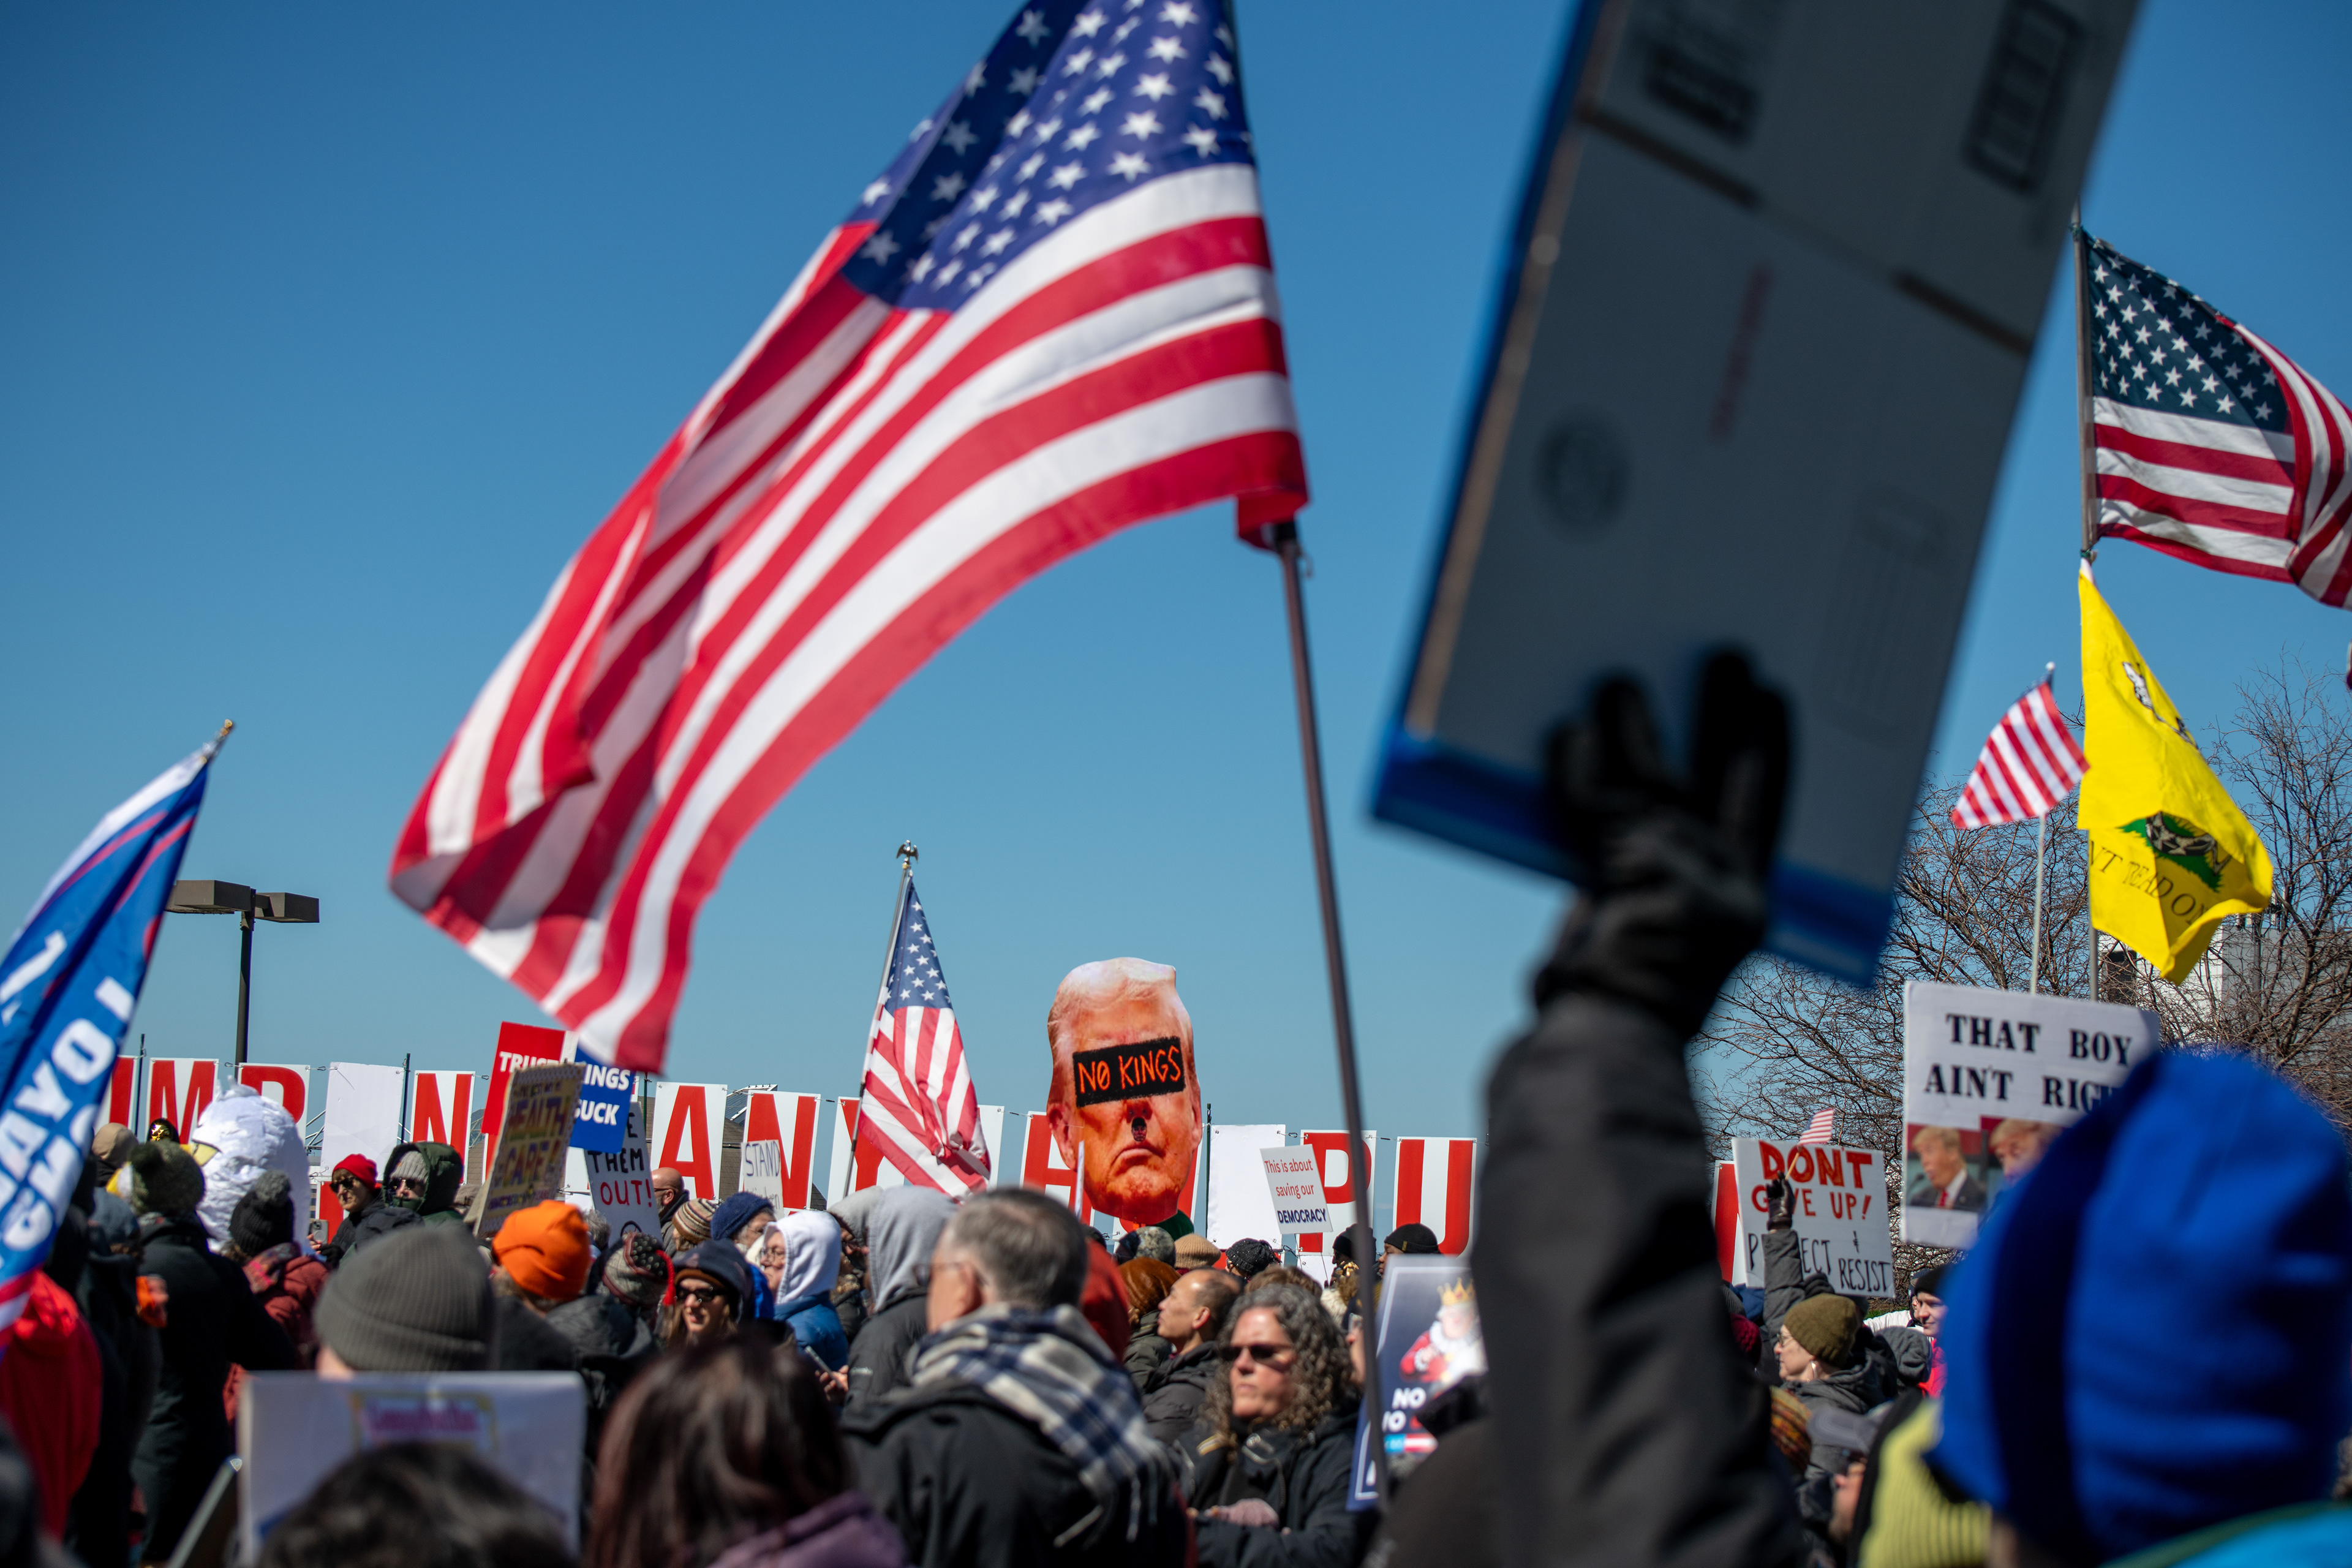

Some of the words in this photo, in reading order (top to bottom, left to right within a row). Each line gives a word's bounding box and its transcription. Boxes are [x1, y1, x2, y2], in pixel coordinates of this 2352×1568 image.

[1946, 1013, 2040, 1053] THAT
[2068, 1028, 2133, 1065] BOY
[499, 1051, 561, 1072] TRU
[583, 1063, 630, 1090] INGS
[1118, 1045, 1182, 1090] KINGS
[1923, 1062, 2013, 1100] AIN'T
[2041, 1075, 2113, 1115] RIG
[587, 1147, 645, 1174] THEM
[745, 1140, 781, 1177] STAND
[1264, 1159, 1281, 1174] This
[1280, 1159, 1289, 1172] is
[1289, 1158, 1314, 1172] about
[1758, 1139, 1872, 1189] DON'T
[600, 1178, 652, 1208] OUT!
[1275, 1182, 1302, 1199] saving
[1300, 1184, 1314, 1195] our
[1751, 1184, 1817, 1216] GE
[1829, 1191, 1872, 1221] UP!
[1276, 1208, 1327, 1224] DEMOCRACY
[1747, 1232, 1831, 1275] PECT
[1838, 1257, 1891, 1292] RESIST
[1392, 1386, 1427, 1409] NO
